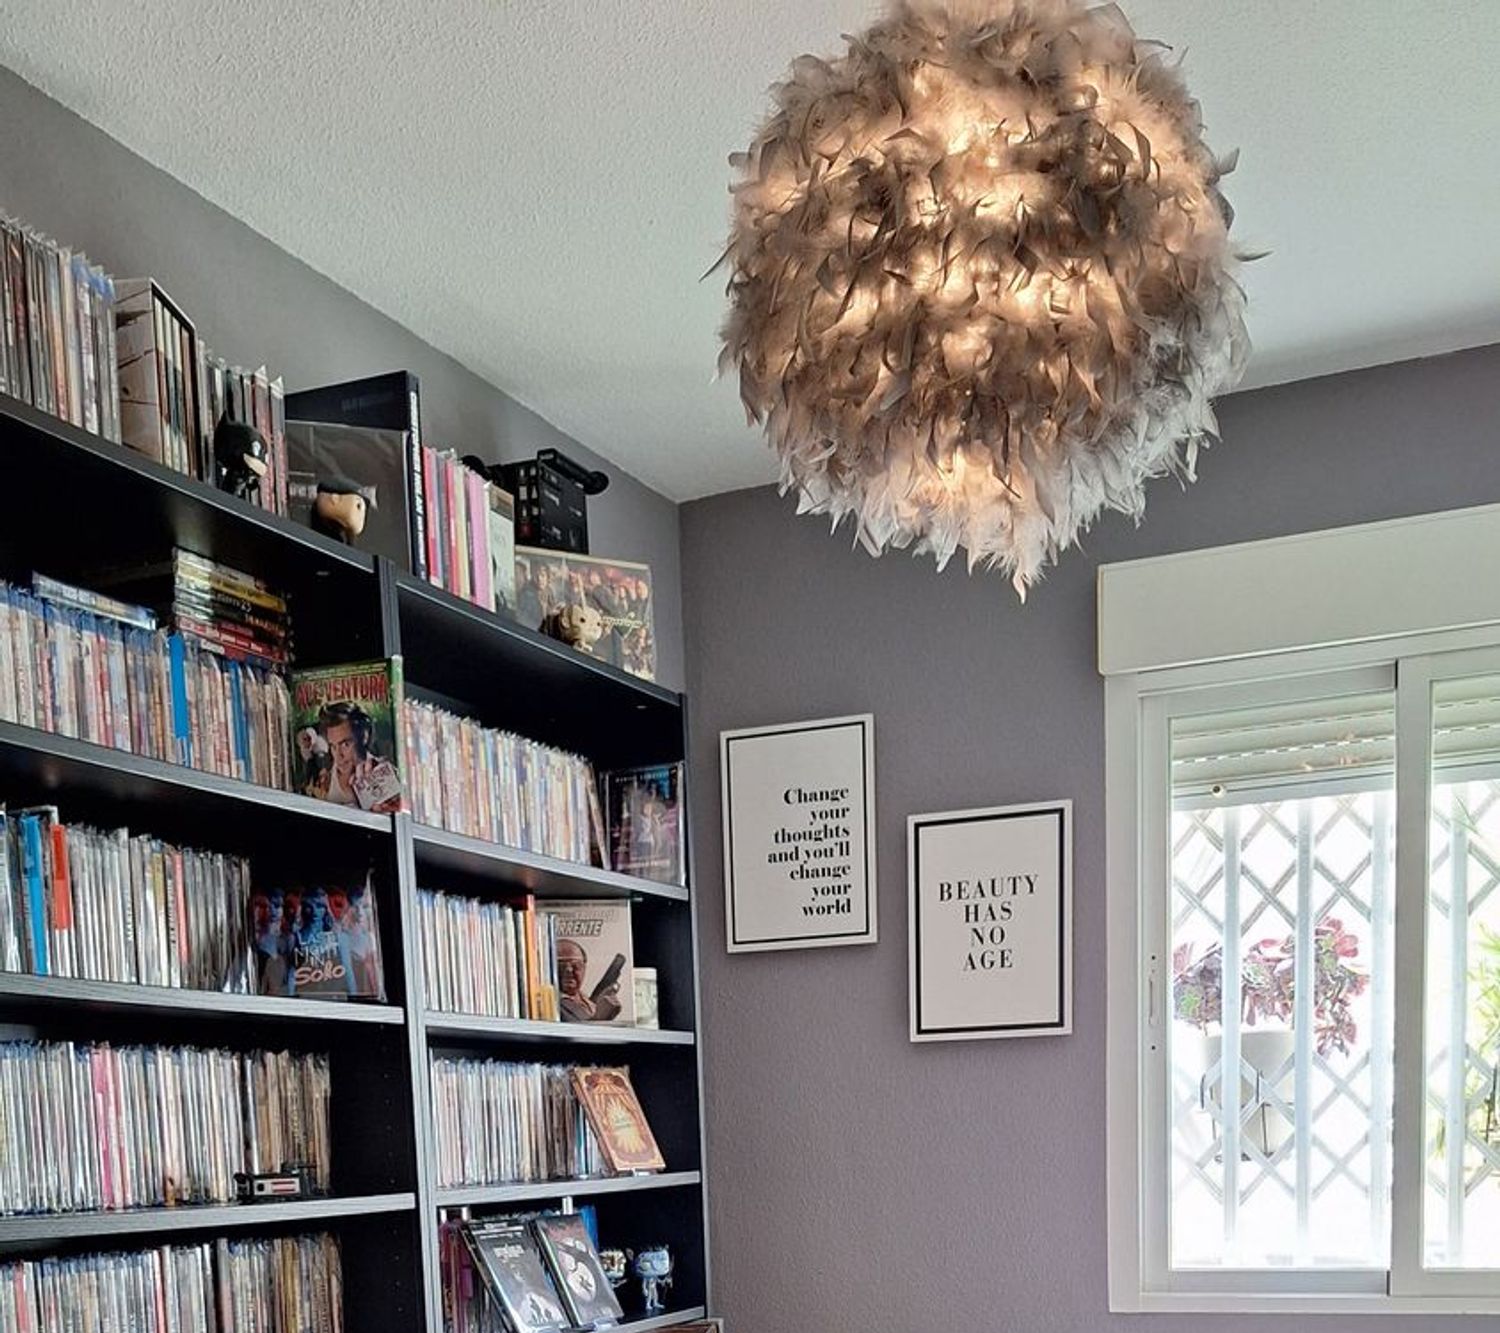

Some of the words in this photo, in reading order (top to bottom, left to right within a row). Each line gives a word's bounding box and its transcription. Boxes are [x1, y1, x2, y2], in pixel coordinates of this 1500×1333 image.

[783, 788, 849, 805] Change
[810, 807, 850, 826] your
[774, 823, 850, 842] thoughts
[767, 845, 799, 864] and
[803, 841, 850, 865] you'll
[789, 864, 851, 880] change
[812, 883, 852, 902] your
[939, 874, 1038, 902] BEAUTY
[802, 898, 851, 916] world
[964, 900, 1013, 923] HAS
[557, 919, 604, 938] RRENTE
[970, 926, 1006, 947] NO
[962, 948, 1013, 972] AGE
